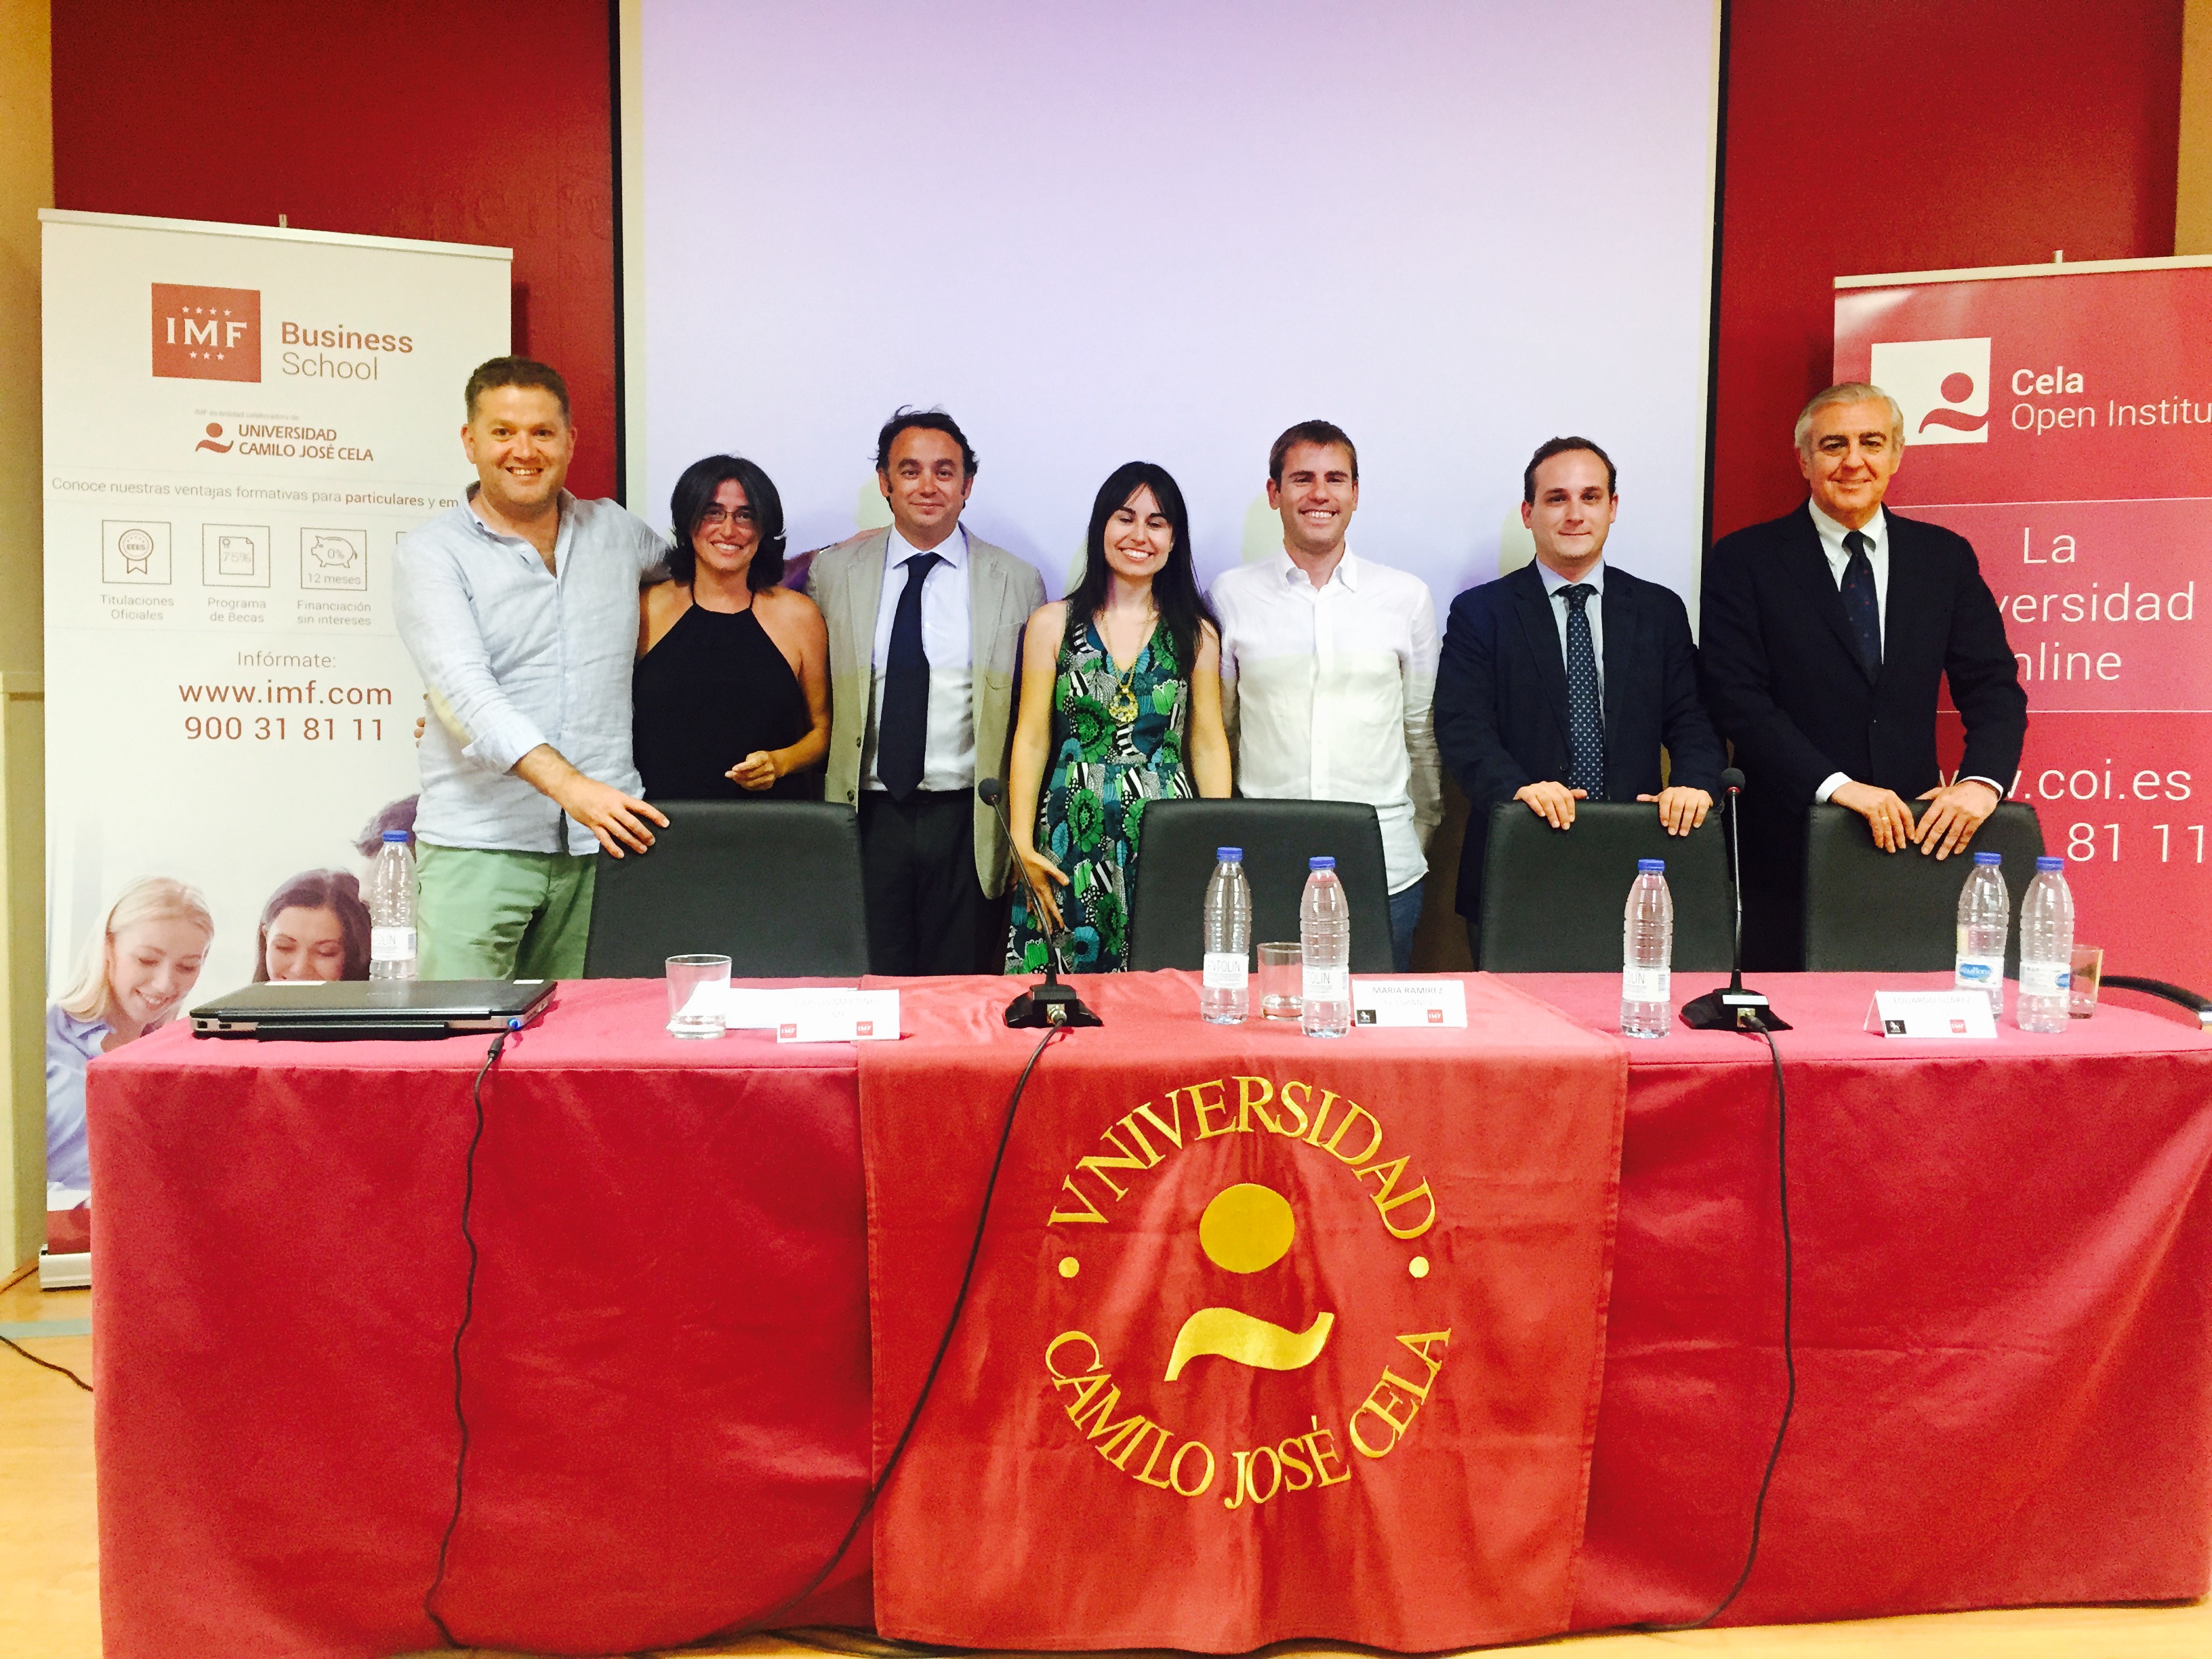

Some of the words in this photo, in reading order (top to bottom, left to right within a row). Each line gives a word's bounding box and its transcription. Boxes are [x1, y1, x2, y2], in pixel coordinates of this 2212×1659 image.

[166, 316, 247, 349] IMF
[281, 321, 413, 354] Business
[281, 352, 378, 381] School
[2011, 365, 2084, 396] Cela
[2011, 403, 2095, 436] Open
[239, 424, 337, 441] UNIVERSIDAD
[239, 442, 295, 457] CAMILO
[299, 444, 334, 459] JOSÉ
[337, 447, 374, 461] CELA
[52, 477, 106, 492] Conoce
[110, 480, 170, 495] nuestras
[175, 483, 232, 499] ventajas
[236, 485, 308, 501] formativas
[312, 491, 342, 503] para
[345, 491, 424, 506] particulares
[428, 497, 436, 509] y
[327, 548, 345, 560] 0%
[2022, 527, 2076, 564] La
[223, 551, 252, 563] 75%
[307, 573, 322, 583] 12
[324, 575, 361, 585] meses
[100, 594, 174, 607] Titulaciones
[207, 597, 266, 611] Programa
[297, 598, 371, 612] Financiación
[110, 608, 164, 621] Oficiales
[209, 611, 224, 622] de
[228, 611, 264, 623] Becas
[297, 613, 315, 624] sin
[318, 615, 372, 626] intereses
[237, 650, 337, 668] Infórmate:
[178, 679, 392, 705] www.imf.com
[184, 716, 242, 740] 900
[254, 717, 285, 740] 31
[303, 717, 333, 740] 81
[352, 718, 382, 741] 11
[2066, 822, 2120, 863] 81
[2152, 824, 2204, 863] 11
[1044, 1330, 1215, 1497] CAMILO
[1223, 1414, 1351, 1509] JOSÉ
[1349, 1327, 1452, 1458] CELA
